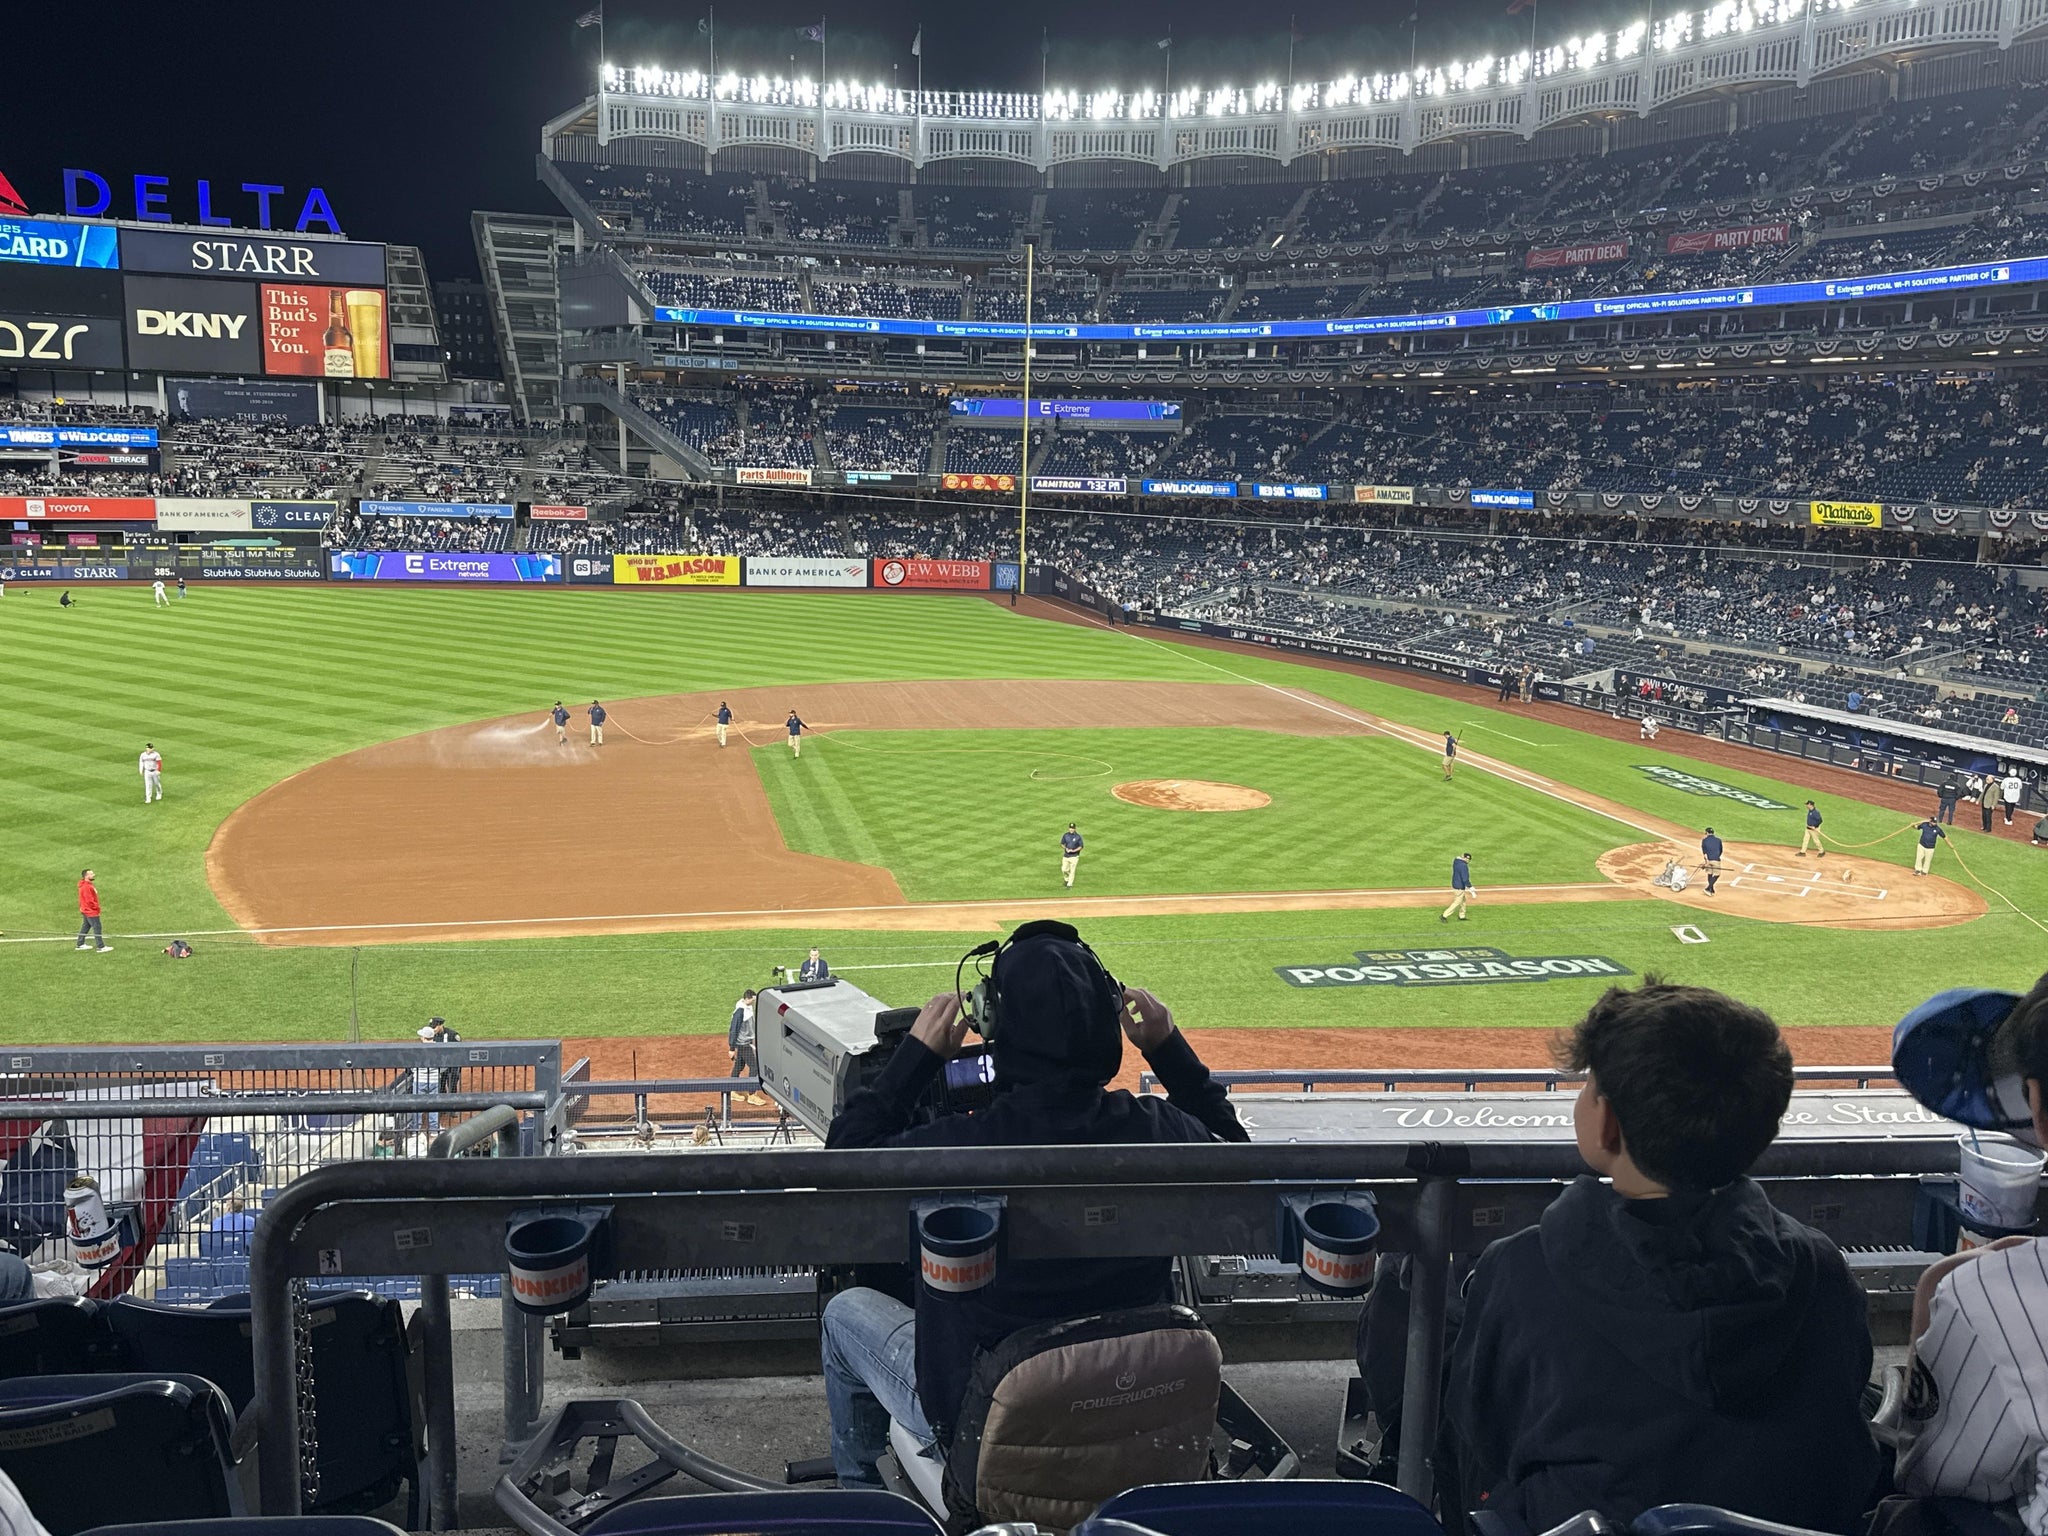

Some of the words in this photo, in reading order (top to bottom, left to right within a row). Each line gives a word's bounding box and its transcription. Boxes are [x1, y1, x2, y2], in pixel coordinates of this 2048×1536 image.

[63, 168, 342, 233] DELTA
[0, 224, 21, 233] 25
[1715, 230, 1750, 247] PARTY
[1752, 226, 1784, 243] DECK
[192, 241, 319, 276] STARR
[1565, 249, 1596, 263] PARTY
[1597, 244, 1623, 260] DECK
[1865, 283, 1892, 291] OFFICIAL
[1894, 281, 1911, 289] WI-FI
[1912, 277, 1948, 287] SOLUTIONS
[1949, 274, 1979, 283] PARTNER
[1980, 272, 1989, 280] OF
[267, 290, 308, 305] This
[1668, 299, 1699, 307] SOLUTIONS
[269, 306, 317, 322] Bud's
[136, 309, 247, 339] DKNY
[270, 323, 299, 337] For
[269, 338, 309, 354] You.
[1054, 405, 1091, 413] Extreme
[236, 413, 258, 421] THE
[261, 413, 288, 421] BOSS
[8, 430, 54, 443] YANKEES
[740, 470, 764, 479] Parts
[765, 470, 807, 481] Authority
[1036, 480, 1081, 489] ARMITRON
[1376, 490, 1410, 500] AMAZING
[285, 511, 332, 521] CLEAR
[532, 508, 564, 516] Reebok
[1817, 503, 1873, 520] Nathan's
[430, 559, 490, 571] Extreme
[644, 558, 658, 566] BUT
[74, 568, 118, 578] STARR
[154, 567, 170, 576] 385
[203, 568, 241, 578] StubHub
[244, 569, 281, 578] StubHub
[284, 569, 320, 578] StubHub
[795, 569, 841, 577] AMERICA
[907, 563, 933, 576] F.W.
[938, 564, 980, 577] WEBB
[1287, 958, 1620, 984] POSTSEASON
[978, 1054, 996, 1083] 3
[1382, 1106, 1576, 1127] Welcom
[1070, 1379, 1186, 1412] POWERWORKS
